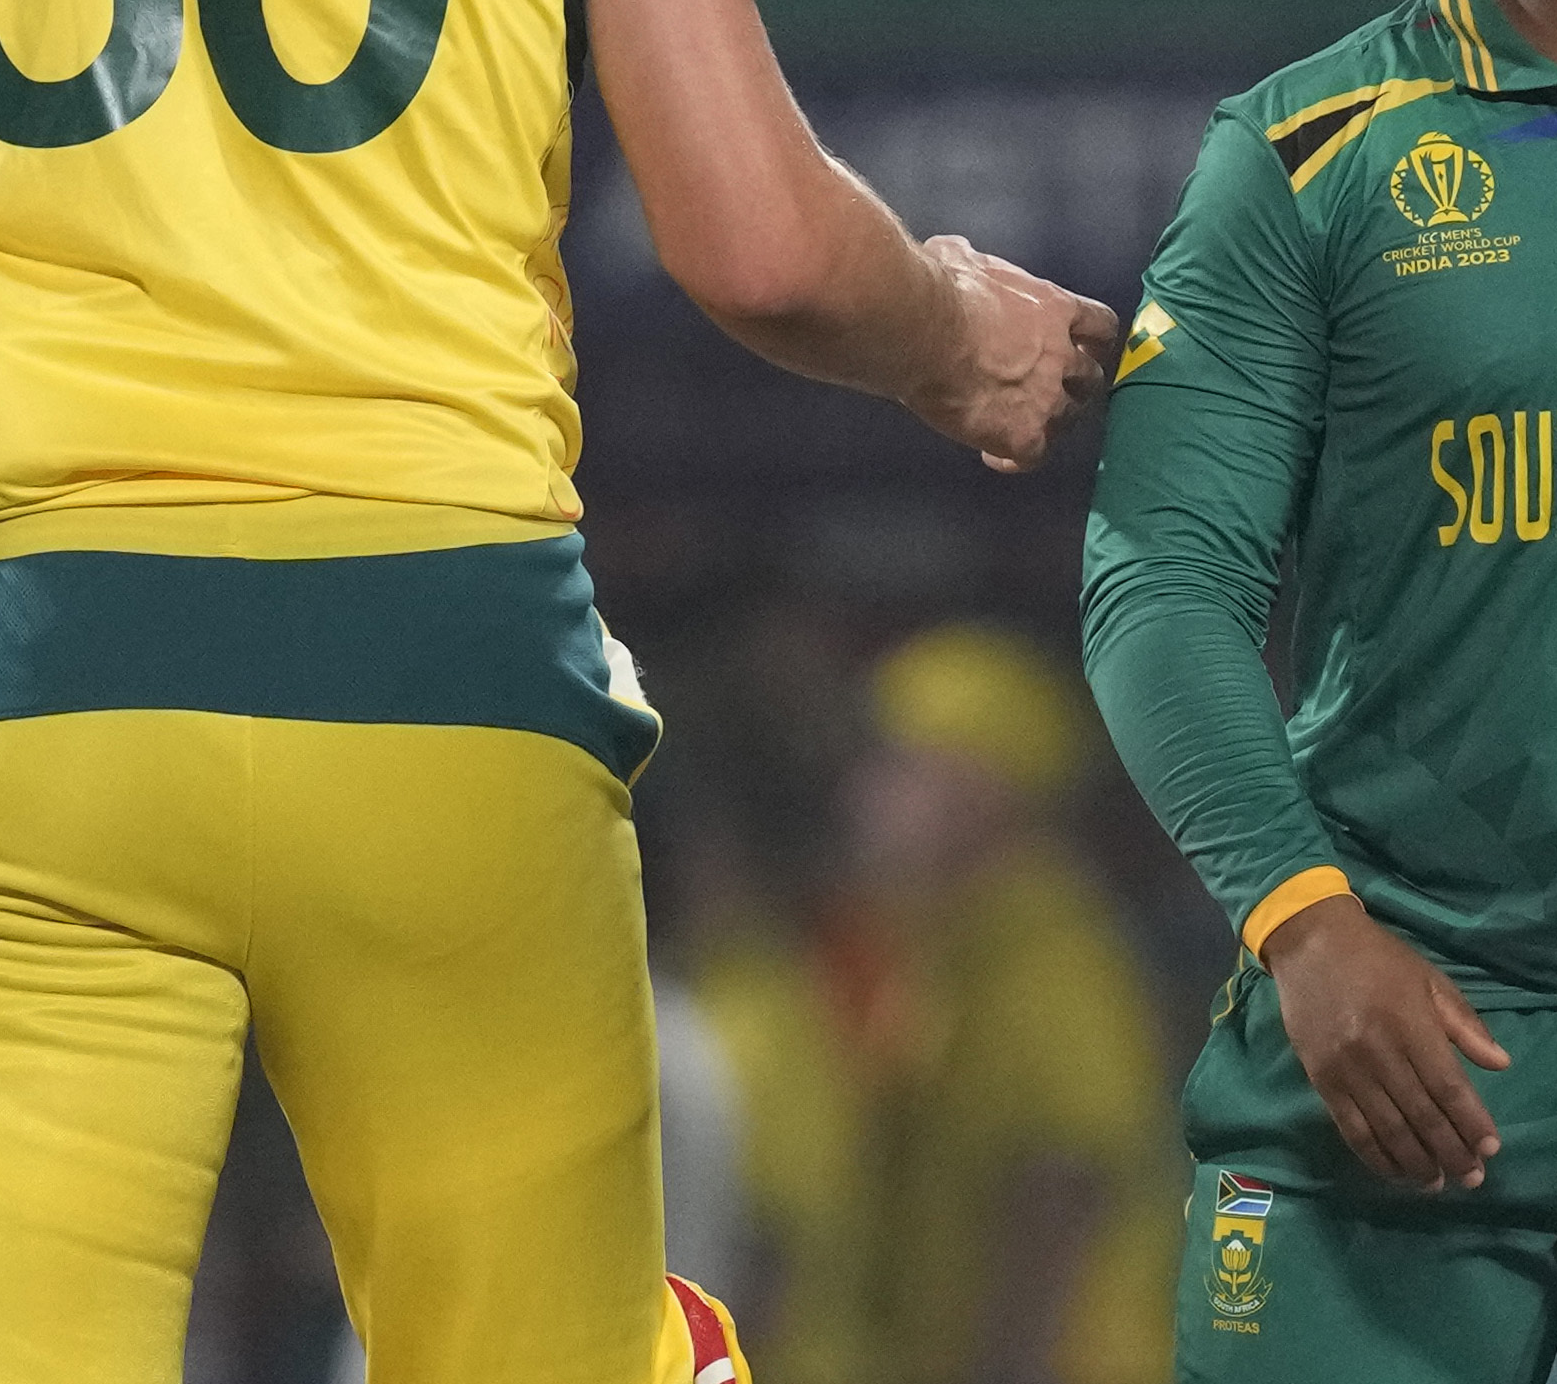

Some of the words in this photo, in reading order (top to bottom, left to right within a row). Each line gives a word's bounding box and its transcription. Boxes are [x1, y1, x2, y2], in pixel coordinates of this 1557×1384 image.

[1417, 231, 1439, 245] ICC
[1441, 227, 1482, 242] MEN'S
[1382, 244, 1437, 262] CRICKET
[1441, 239, 1491, 253] WORLD
[1493, 235, 1521, 247] CUP
[1396, 255, 1453, 277] INDIA
[1456, 249, 1511, 267] 2023
[1212, 1319, 1261, 1334] PROTEAS
